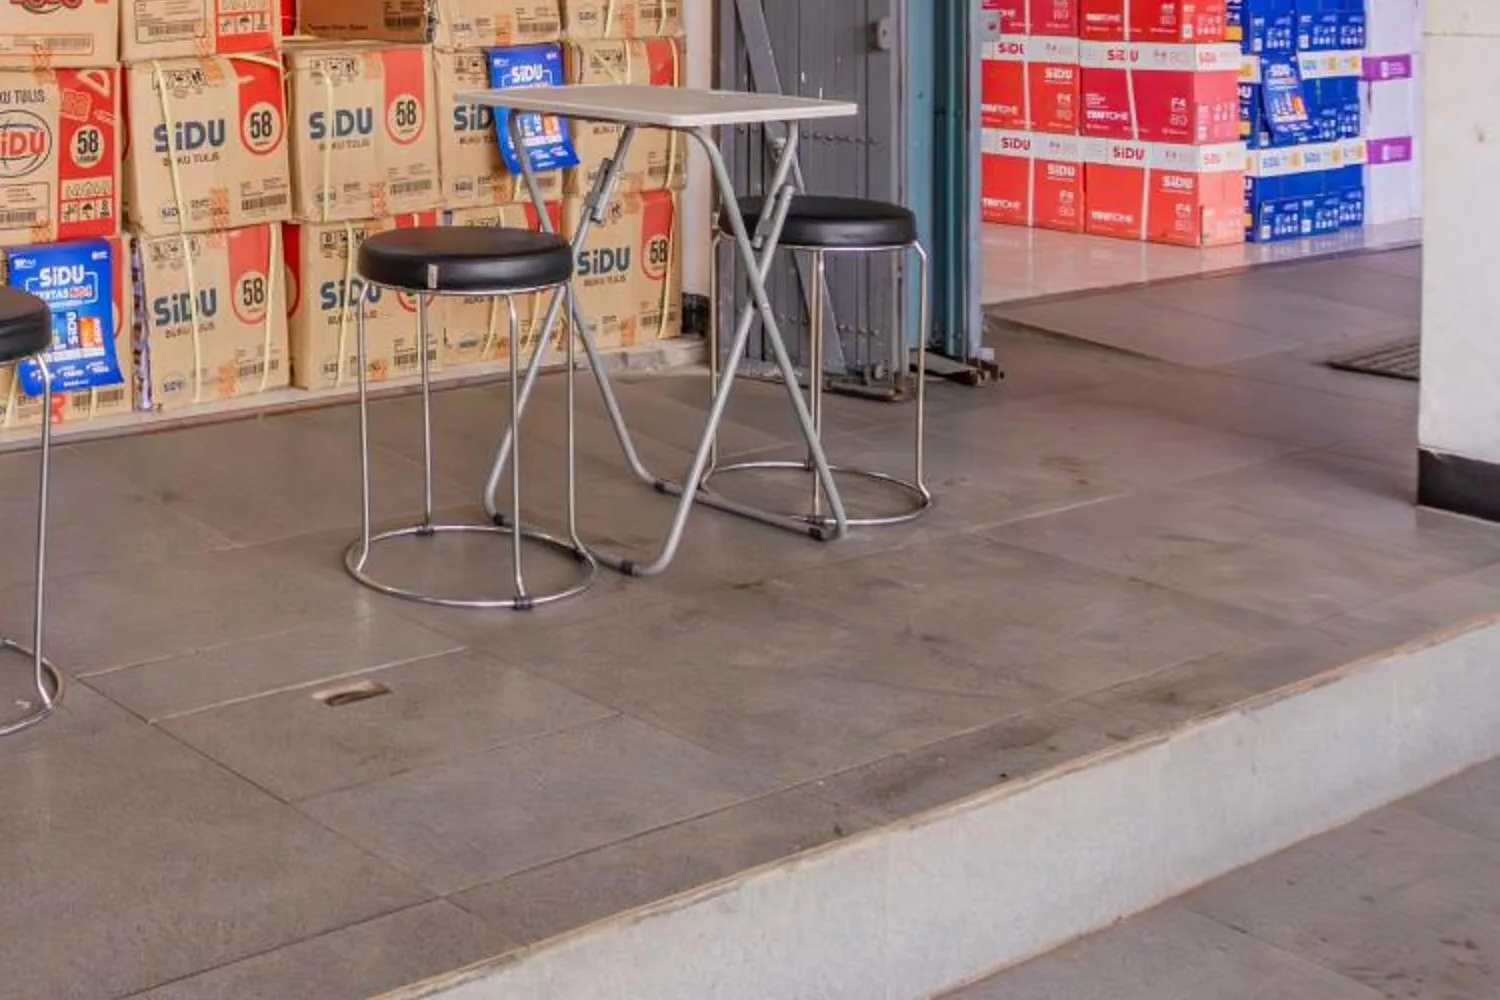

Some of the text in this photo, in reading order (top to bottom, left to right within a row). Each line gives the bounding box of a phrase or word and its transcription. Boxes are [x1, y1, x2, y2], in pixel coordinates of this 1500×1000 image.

[1044, 67, 1073, 80] SiDU
[14, 90, 45, 104] TULIS
[249, 110, 273, 139] 58
[395, 100, 417, 127] 58
[453, 105, 492, 131] SiD
[77, 129, 98, 154] 58
[153, 118, 225, 153] SiDU
[1001, 137, 1031, 150] SiDU
[1113, 146, 1145, 161] SiDU
[1047, 163, 1076, 177] SiDU
[1162, 175, 1194, 189] SiDU
[577, 246, 631, 276] SiDU
[39, 264, 85, 288] SiDU
[242, 277, 264, 306] 58
[153, 287, 218, 327] SiDU
